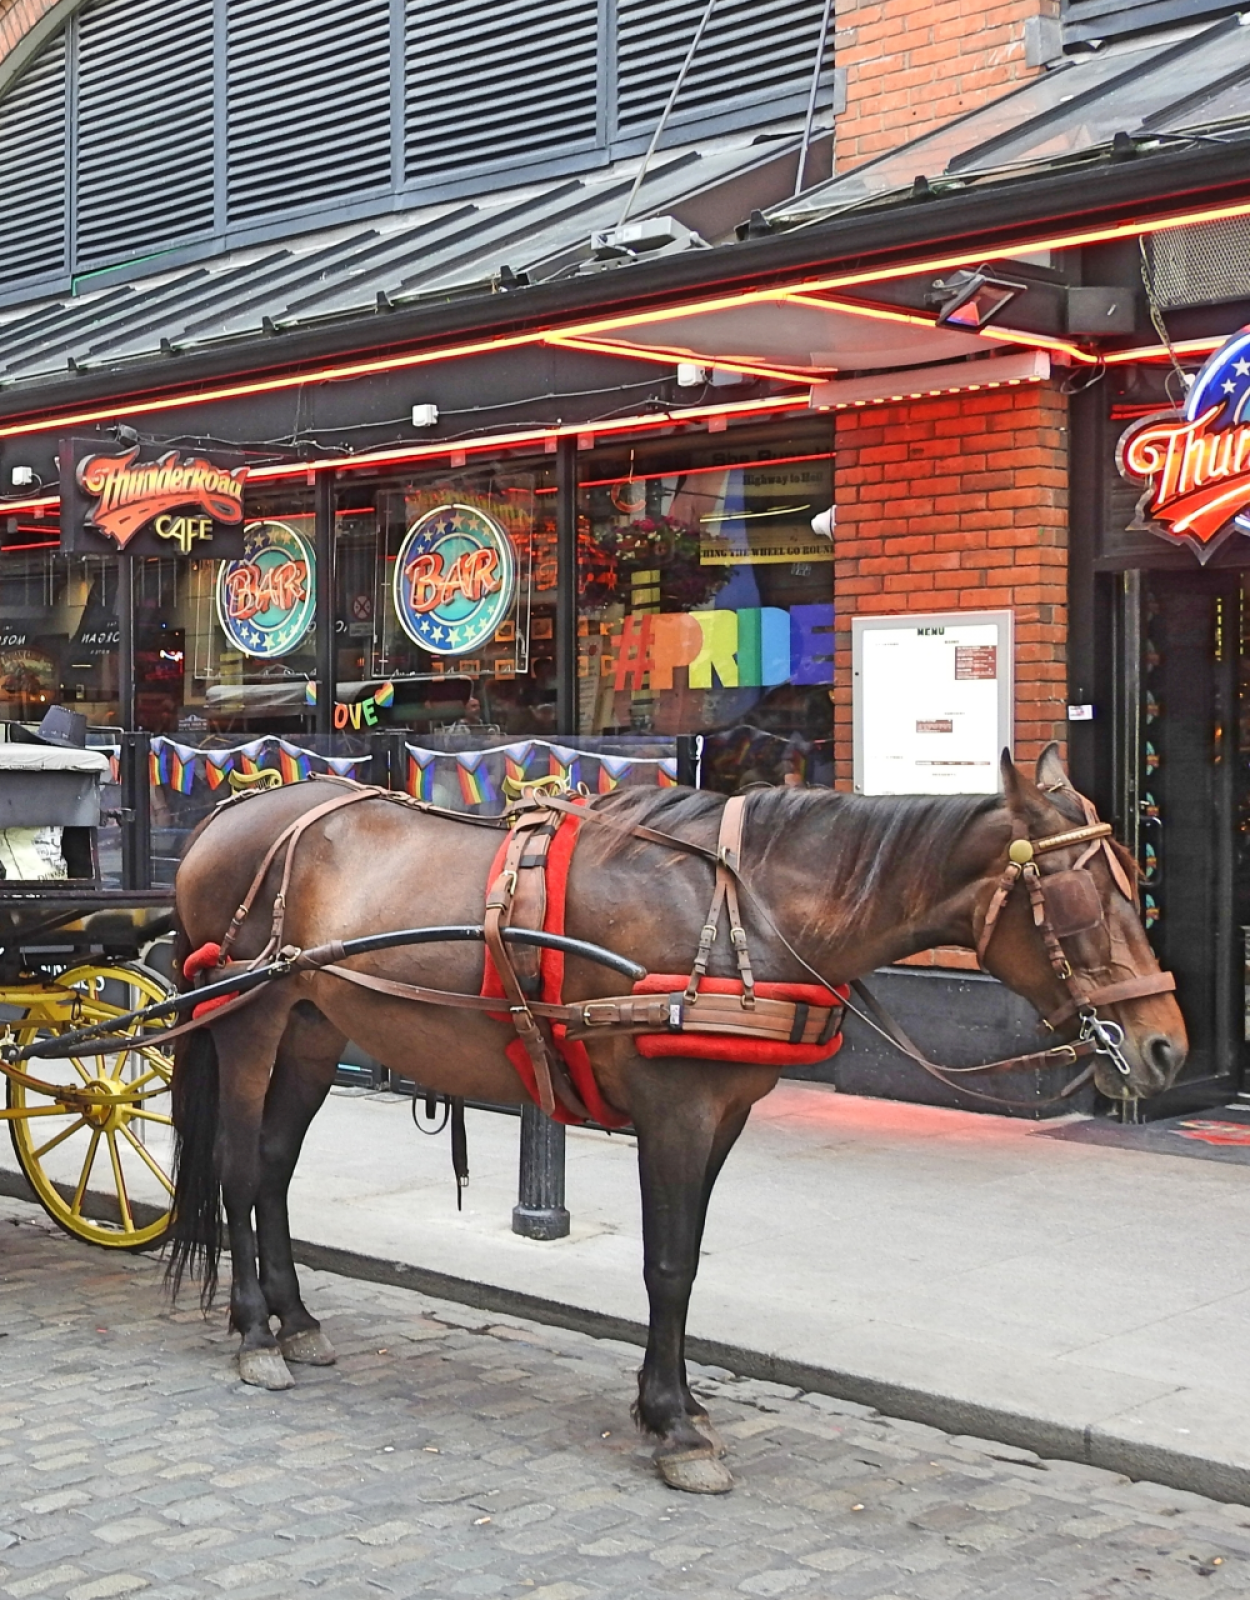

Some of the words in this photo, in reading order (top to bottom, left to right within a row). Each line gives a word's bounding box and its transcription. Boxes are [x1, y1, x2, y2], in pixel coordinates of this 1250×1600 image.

[155, 515, 213, 555] CAFE
[751, 546, 786, 556] WHEEL
[787, 546, 801, 556] GO
[226, 559, 307, 620] BAR
[405, 548, 502, 614] BAR
[611, 604, 835, 691] #PRIDE
[917, 627, 945, 636] MENU
